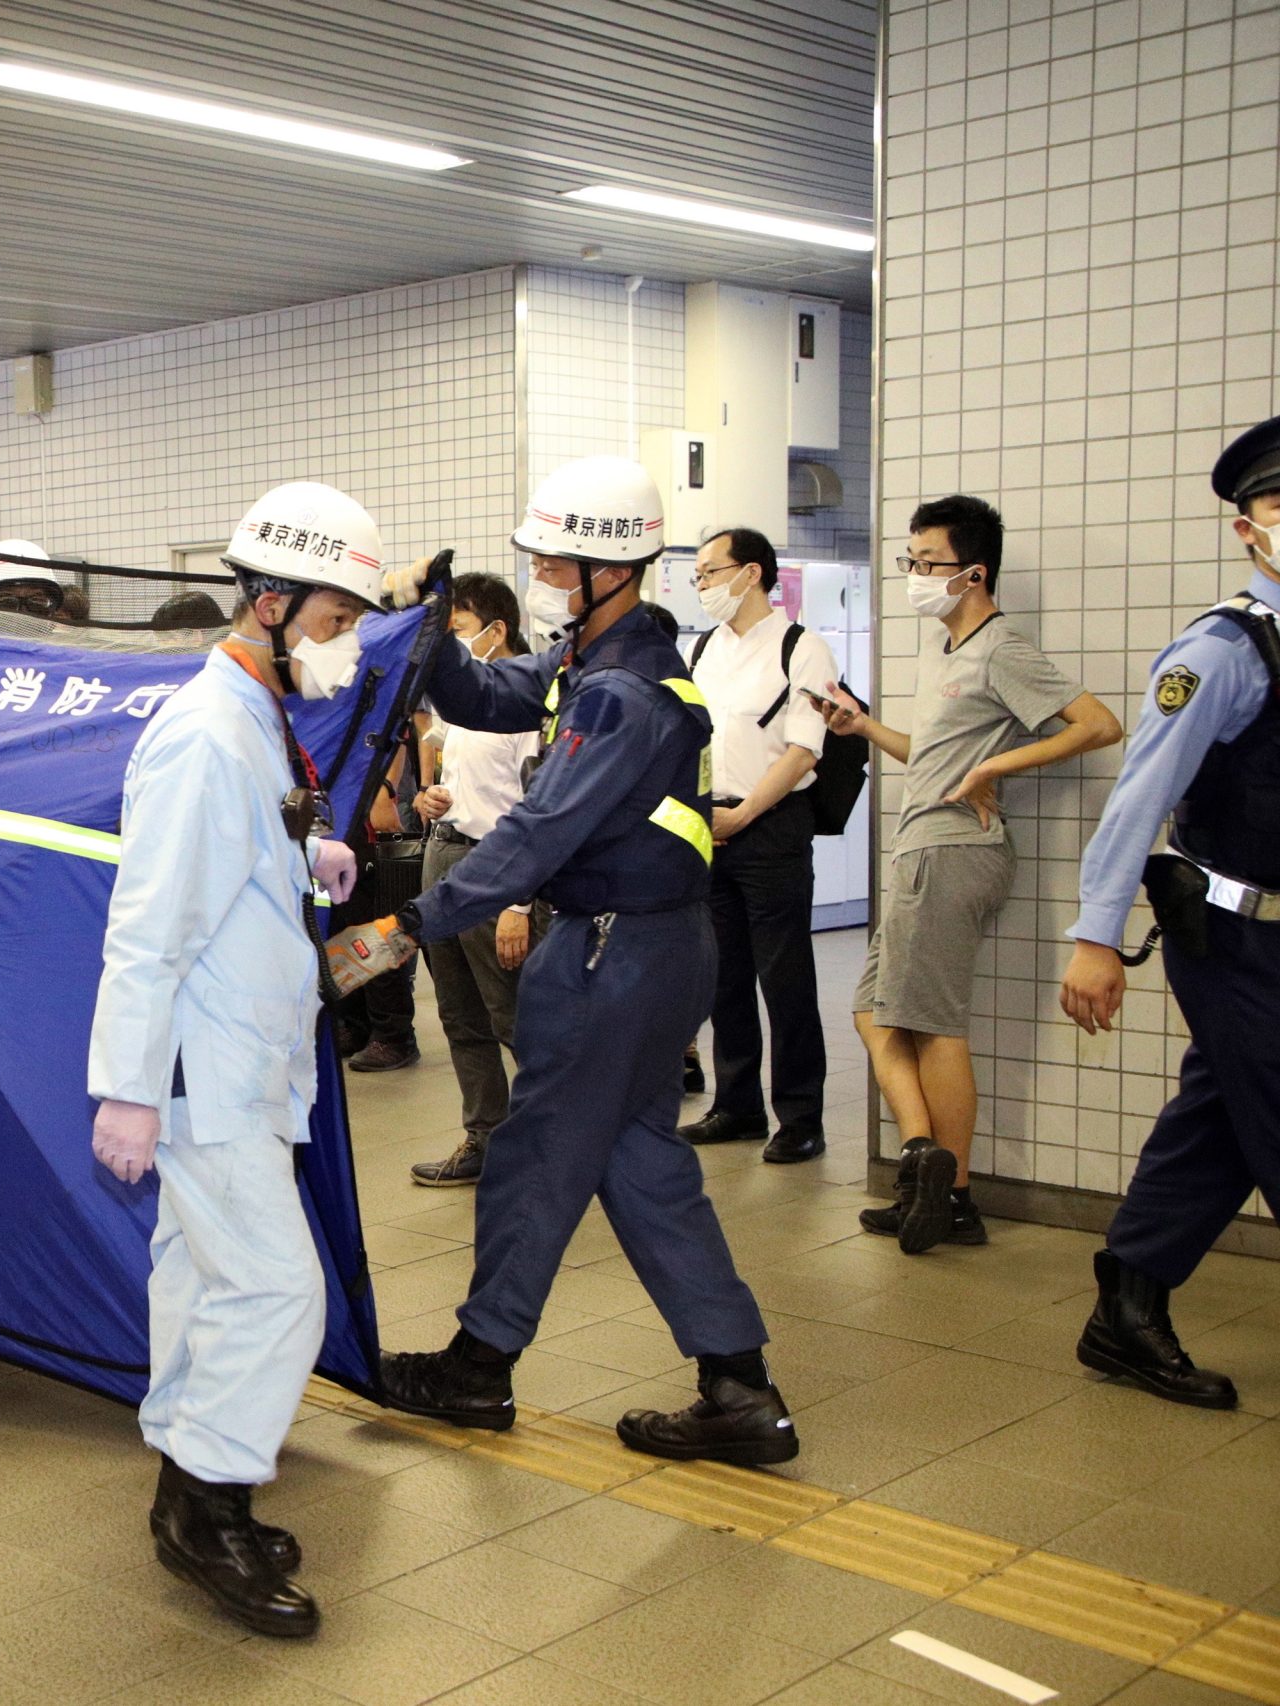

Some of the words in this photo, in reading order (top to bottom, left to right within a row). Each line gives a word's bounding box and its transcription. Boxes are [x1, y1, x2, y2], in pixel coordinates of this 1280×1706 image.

[255, 521, 347, 562] 東京消防庁
[561, 513, 644, 539] 東京消防庁
